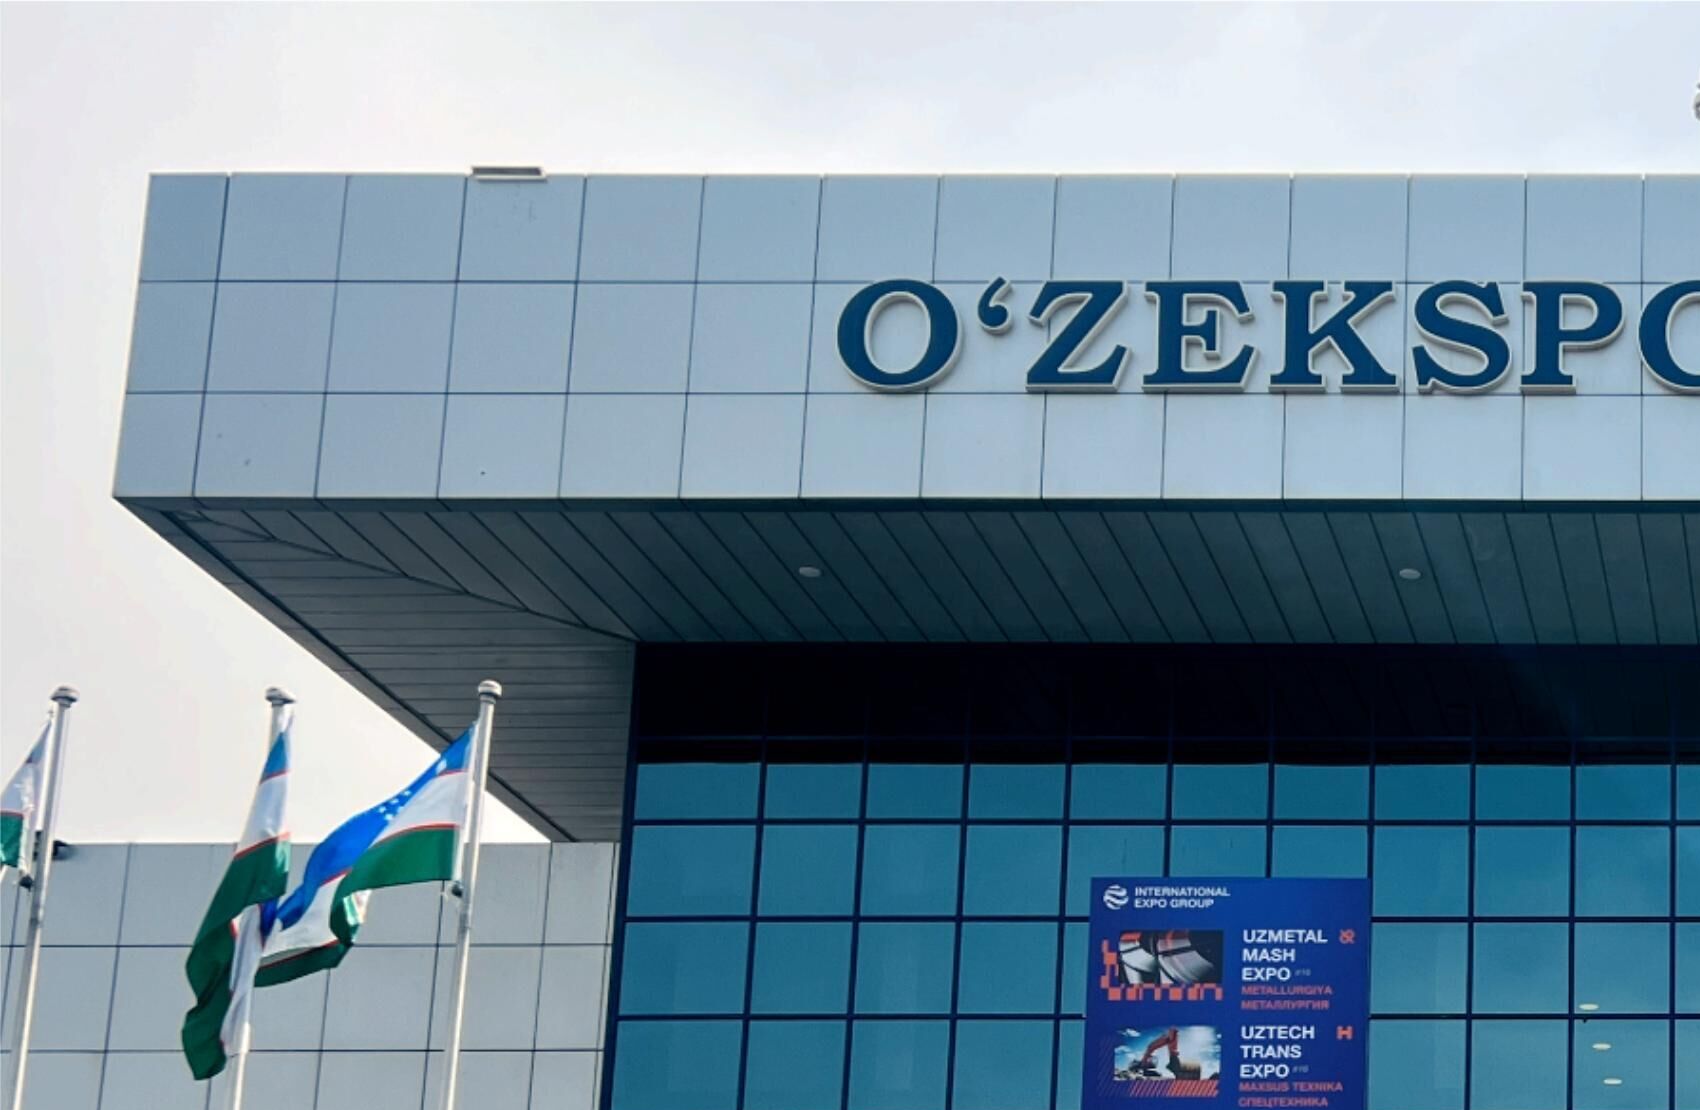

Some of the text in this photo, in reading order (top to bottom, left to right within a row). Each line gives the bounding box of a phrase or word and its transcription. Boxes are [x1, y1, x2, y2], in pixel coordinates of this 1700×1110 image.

[1134, 886, 1230, 897] INTERNATIONAL
[1134, 898, 1215, 909] EXPO GROUP
[1243, 929, 1328, 943] UZMETAL
[1242, 949, 1296, 962] MASH
[1241, 967, 1291, 981] EXPO
[1241, 985, 1333, 996] METALLURGIYA
[1240, 1025, 1315, 1039] UZTECH
[1240, 1045, 1302, 1058] TRANS
[1239, 1064, 1290, 1078] EXPO
[1238, 1081, 1343, 1092] MAXSUS TEXNIKA
